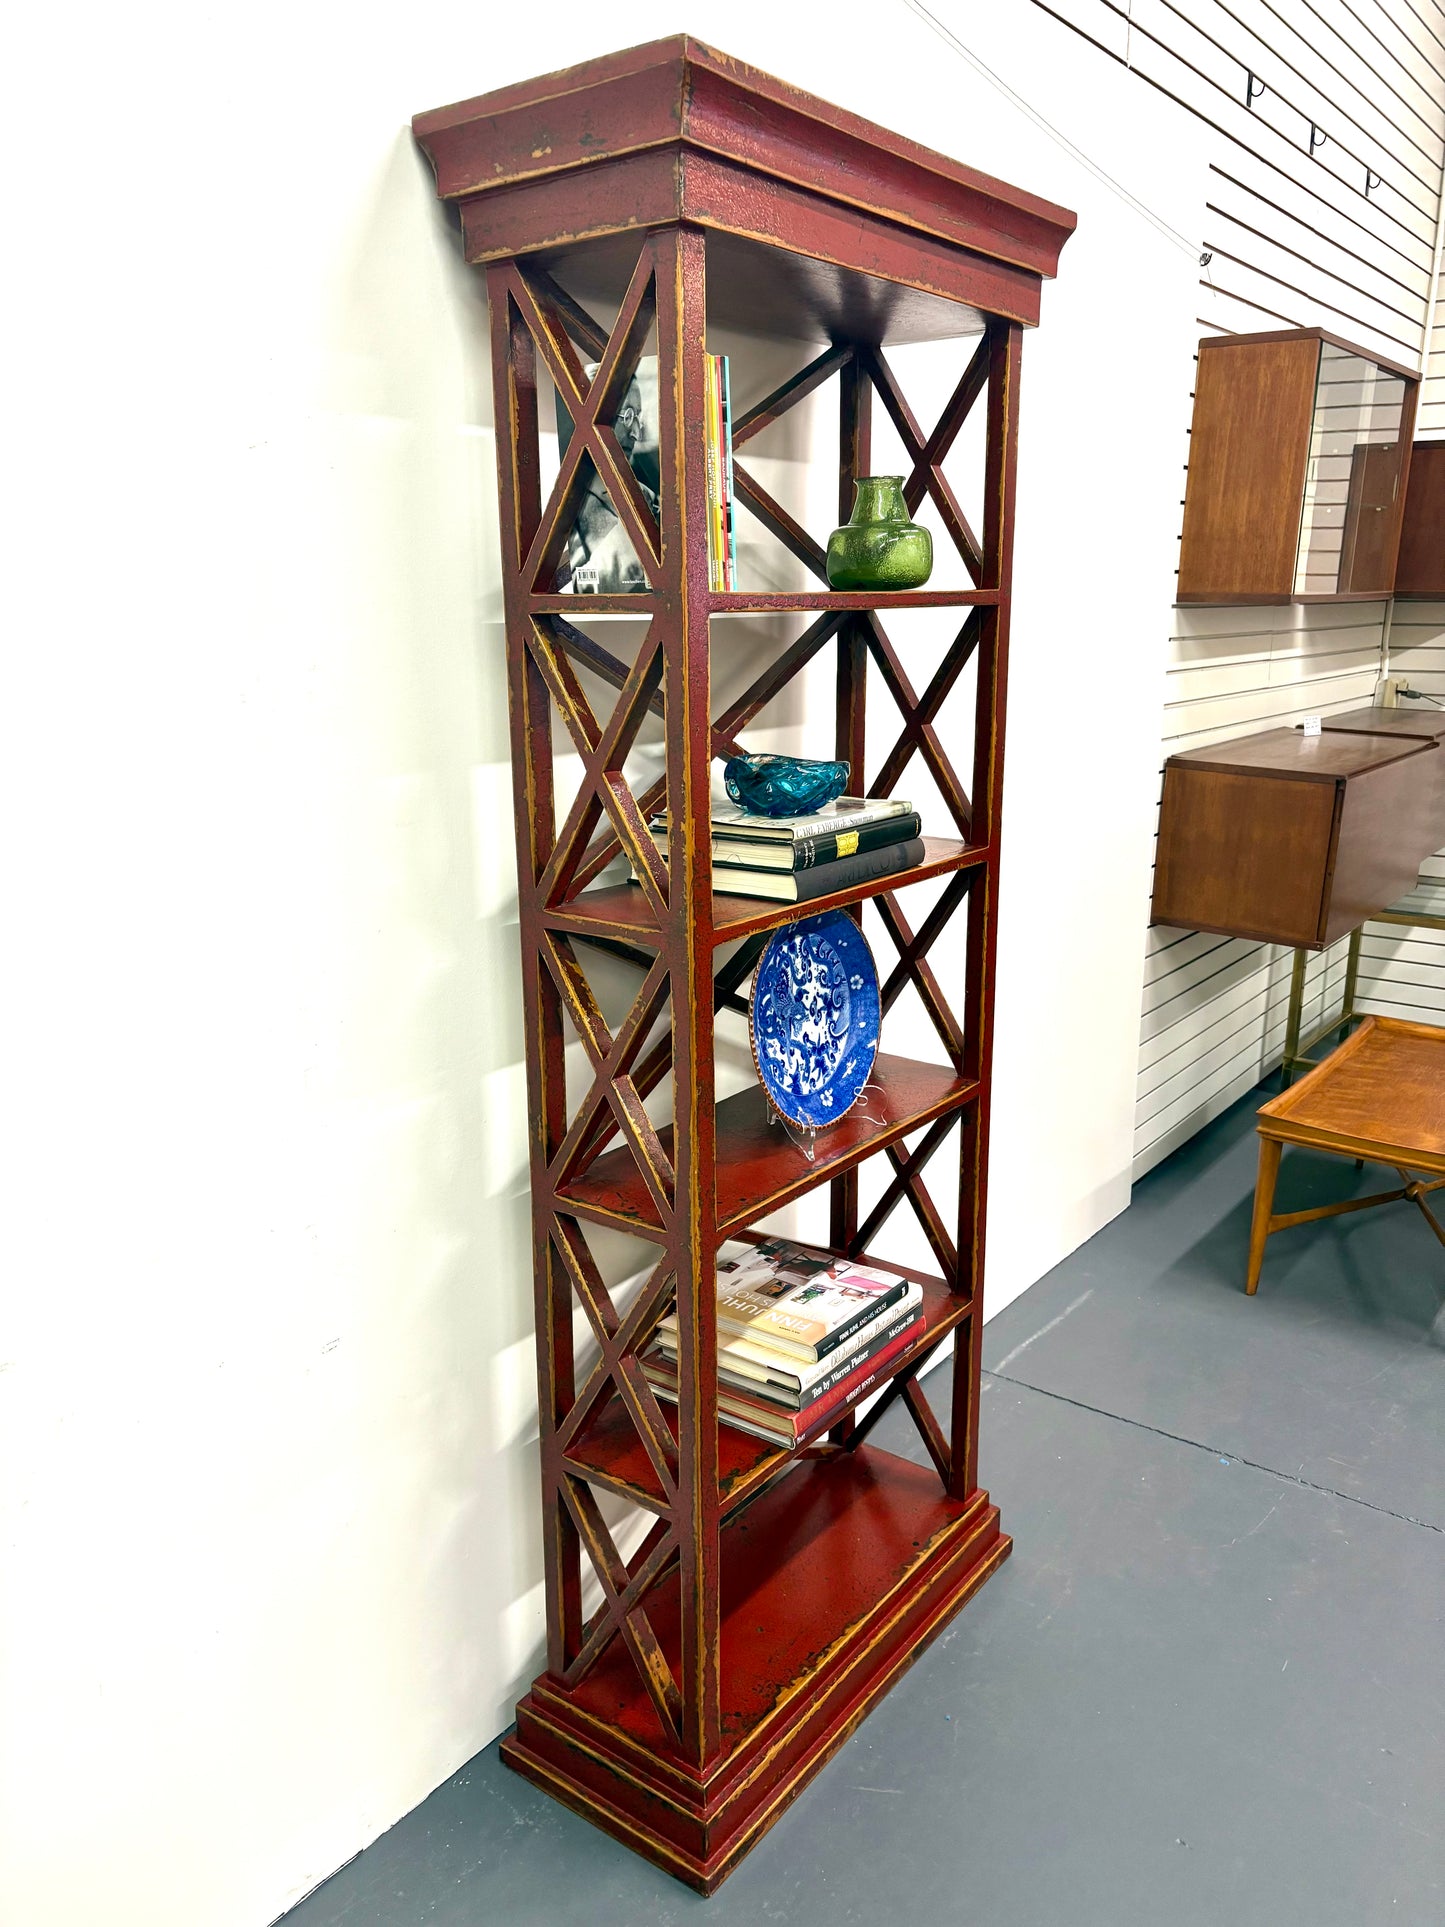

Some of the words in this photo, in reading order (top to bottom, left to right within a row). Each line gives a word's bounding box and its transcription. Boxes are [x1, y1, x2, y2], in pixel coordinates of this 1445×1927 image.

[796, 826, 816, 839] CARL
[720, 1295, 769, 1316] JUHL
[763, 1310, 813, 1332] FINN
[838, 1327, 849, 1342] FINN
[848, 1322, 859, 1335] JUHL
[858, 1315, 868, 1328] AND
[874, 1301, 887, 1316] HOUSE
[888, 1313, 915, 1339] McGraw-Hill
[811, 1387, 823, 1399] Ten
[822, 1379, 831, 1391] by
[830, 1364, 851, 1383] Warren
[850, 1349, 870, 1369] Platner
